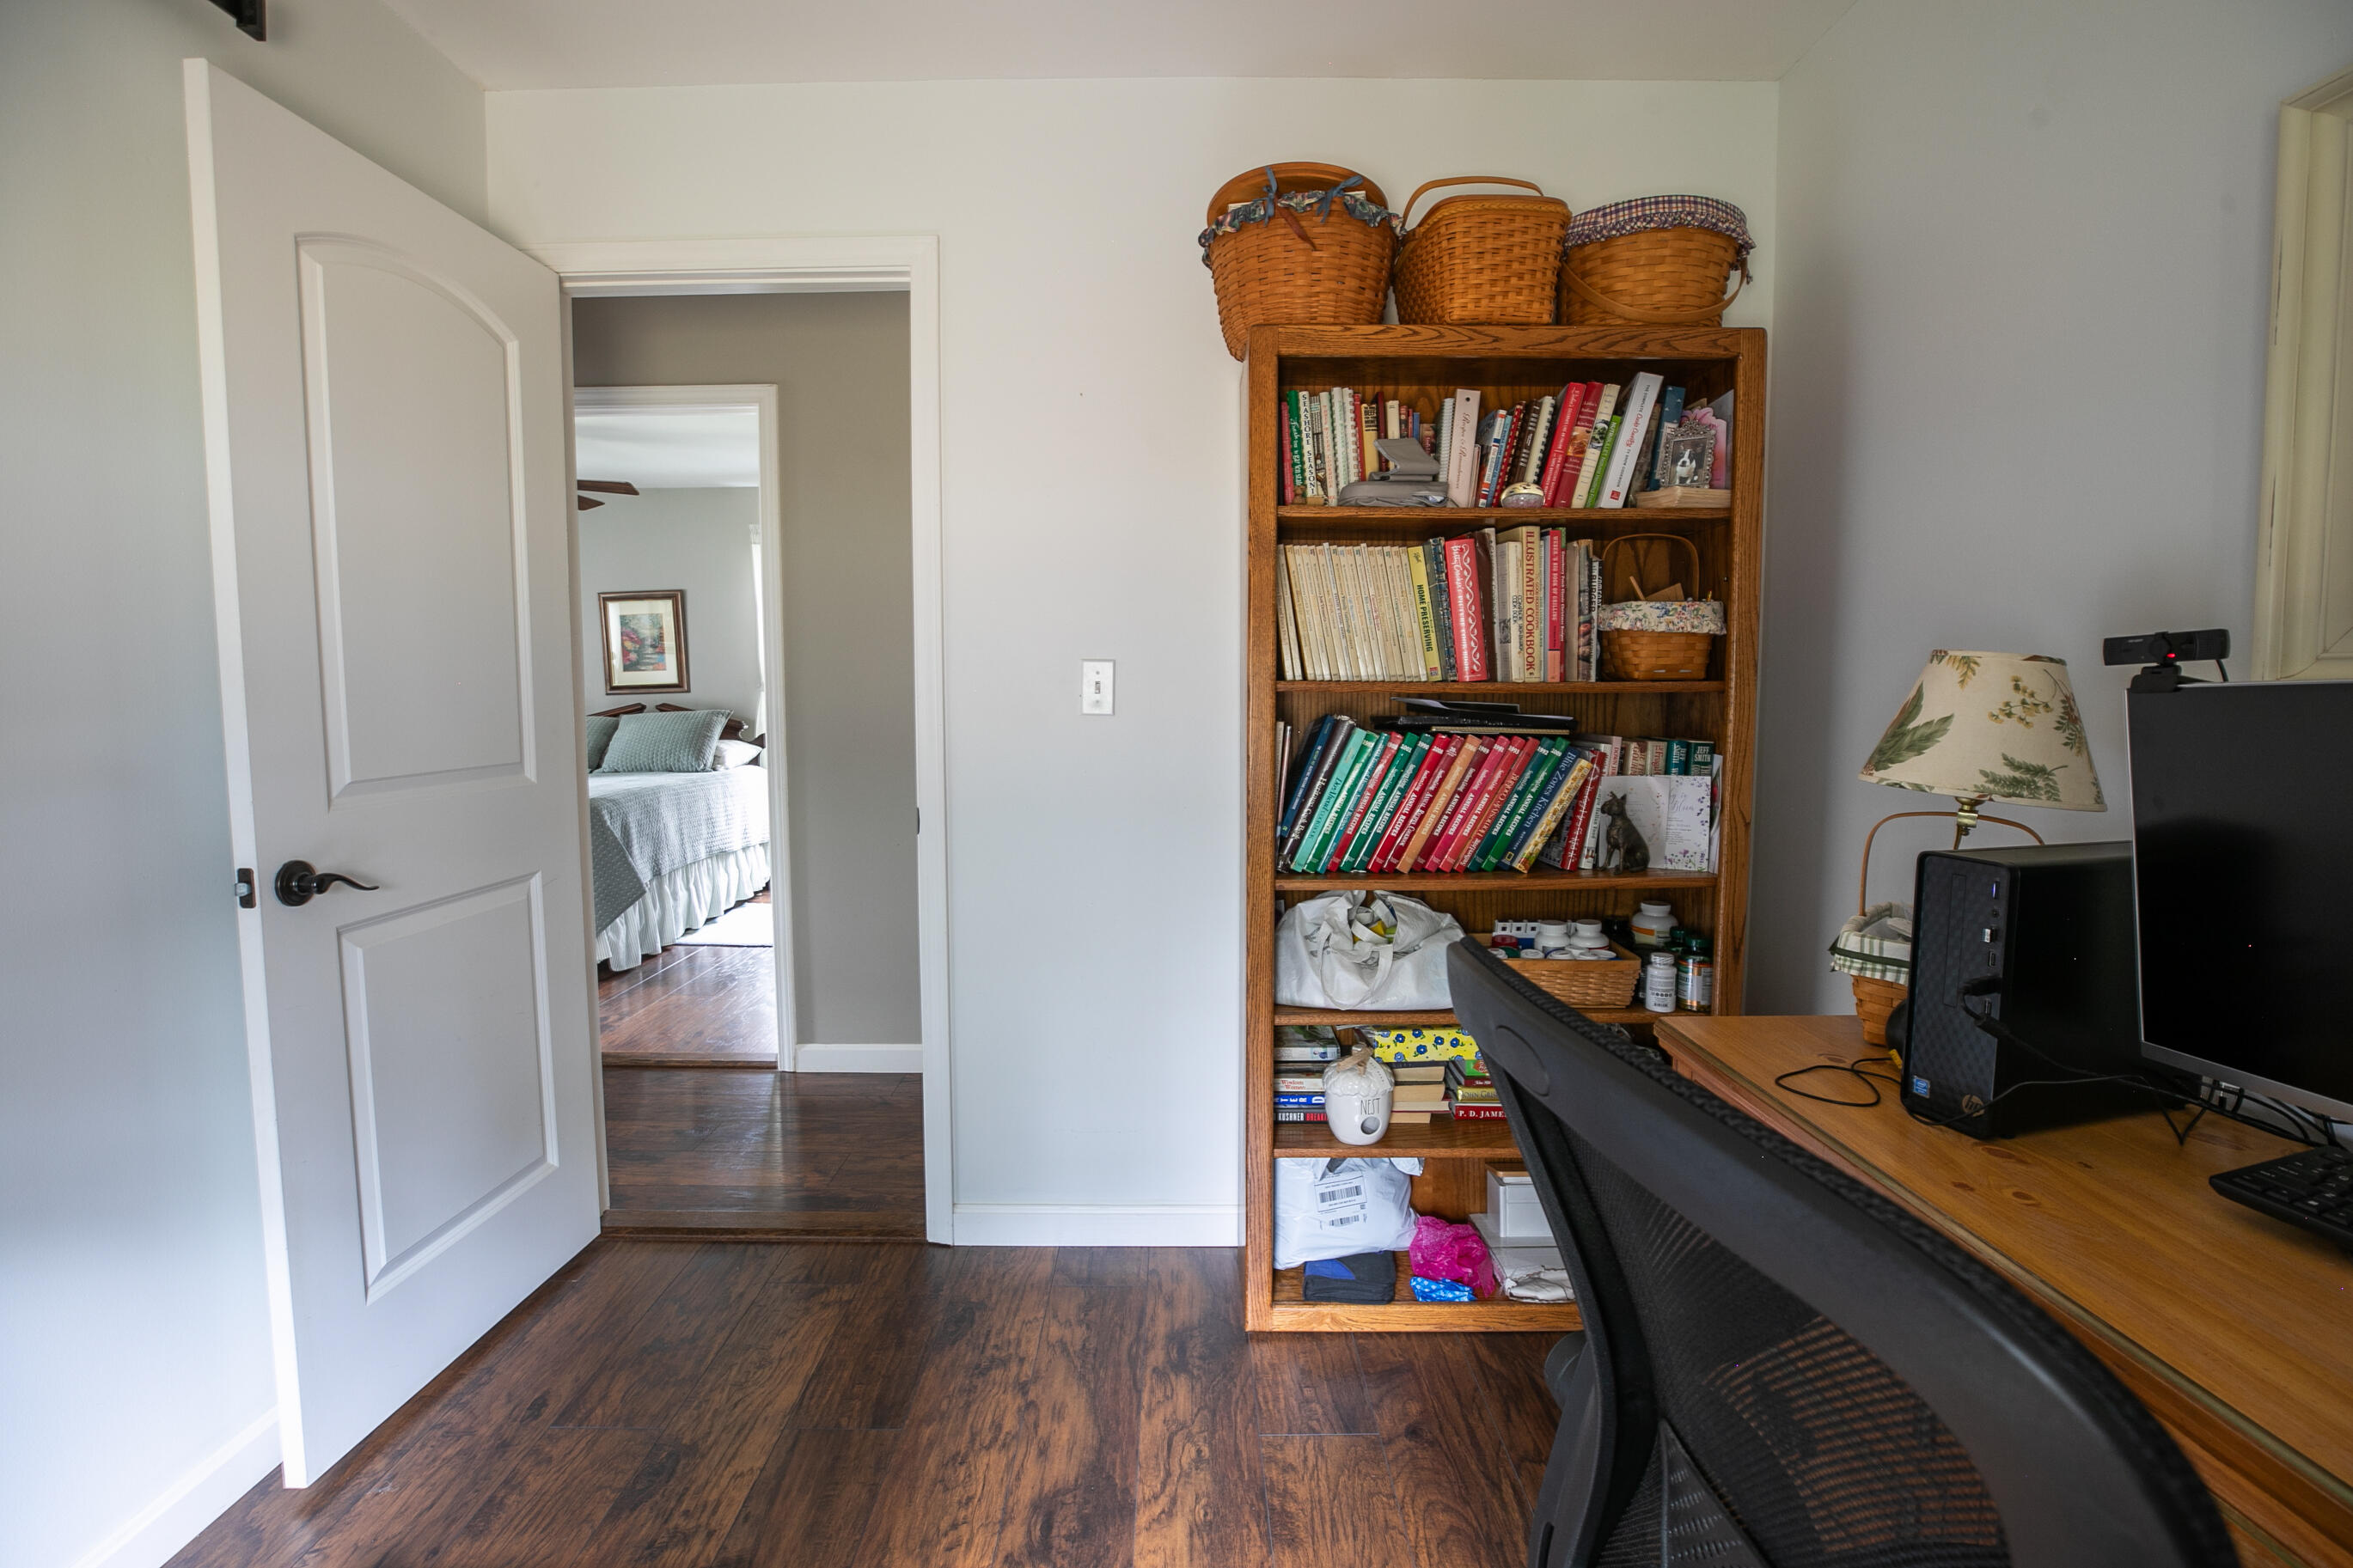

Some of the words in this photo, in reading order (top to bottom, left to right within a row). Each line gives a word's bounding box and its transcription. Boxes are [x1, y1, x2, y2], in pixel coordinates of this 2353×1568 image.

[1301, 394, 1311, 445] SEASHORE
[1525, 531, 1534, 604] ILLUSTRATED
[1416, 583, 1426, 604] HOME
[1420, 606, 1433, 651] PRESERVING
[1525, 607, 1534, 671] COOKBOOK
[1558, 750, 1576, 772] Blue
[1672, 742, 1680, 763] SMITH
[1695, 753, 1711, 762] SMITH
[1543, 770, 1564, 797] Zones
[1335, 790, 1348, 811] ANNUAL
[1356, 790, 1372, 813] ANNUAL
[1372, 790, 1386, 813] ANNUAL
[1387, 790, 1402, 812] ANNUAL
[1402, 792, 1417, 815] ANNUAL
[1432, 791, 1447, 815] ANNUAL
[1445, 793, 1460, 815] ANNUAL
[1459, 791, 1475, 815] ANNUAL
[1474, 792, 1489, 815] ANNUAL
[1503, 792, 1519, 815] ANNUAL
[1518, 792, 1533, 815] ANNUAL
[1323, 812, 1338, 834] RECIPES
[1346, 812, 1360, 834] RECIPES
[1360, 812, 1375, 835] RECIPES
[1375, 811, 1390, 833] RECIPES
[1421, 813, 1436, 835] RECIPES
[1523, 796, 1549, 829] Kitchen
[1390, 814, 1406, 837] RECIPES
[1433, 814, 1448, 837] RECIPES
[1447, 813, 1463, 836] RECIPES
[1462, 814, 1477, 836] RECIPES
[1491, 814, 1507, 836] RECIPES
[1505, 814, 1521, 837] RECIPES
[1279, 1113, 1304, 1121] KUSHNER
[1360, 1098, 1380, 1115] NEST
